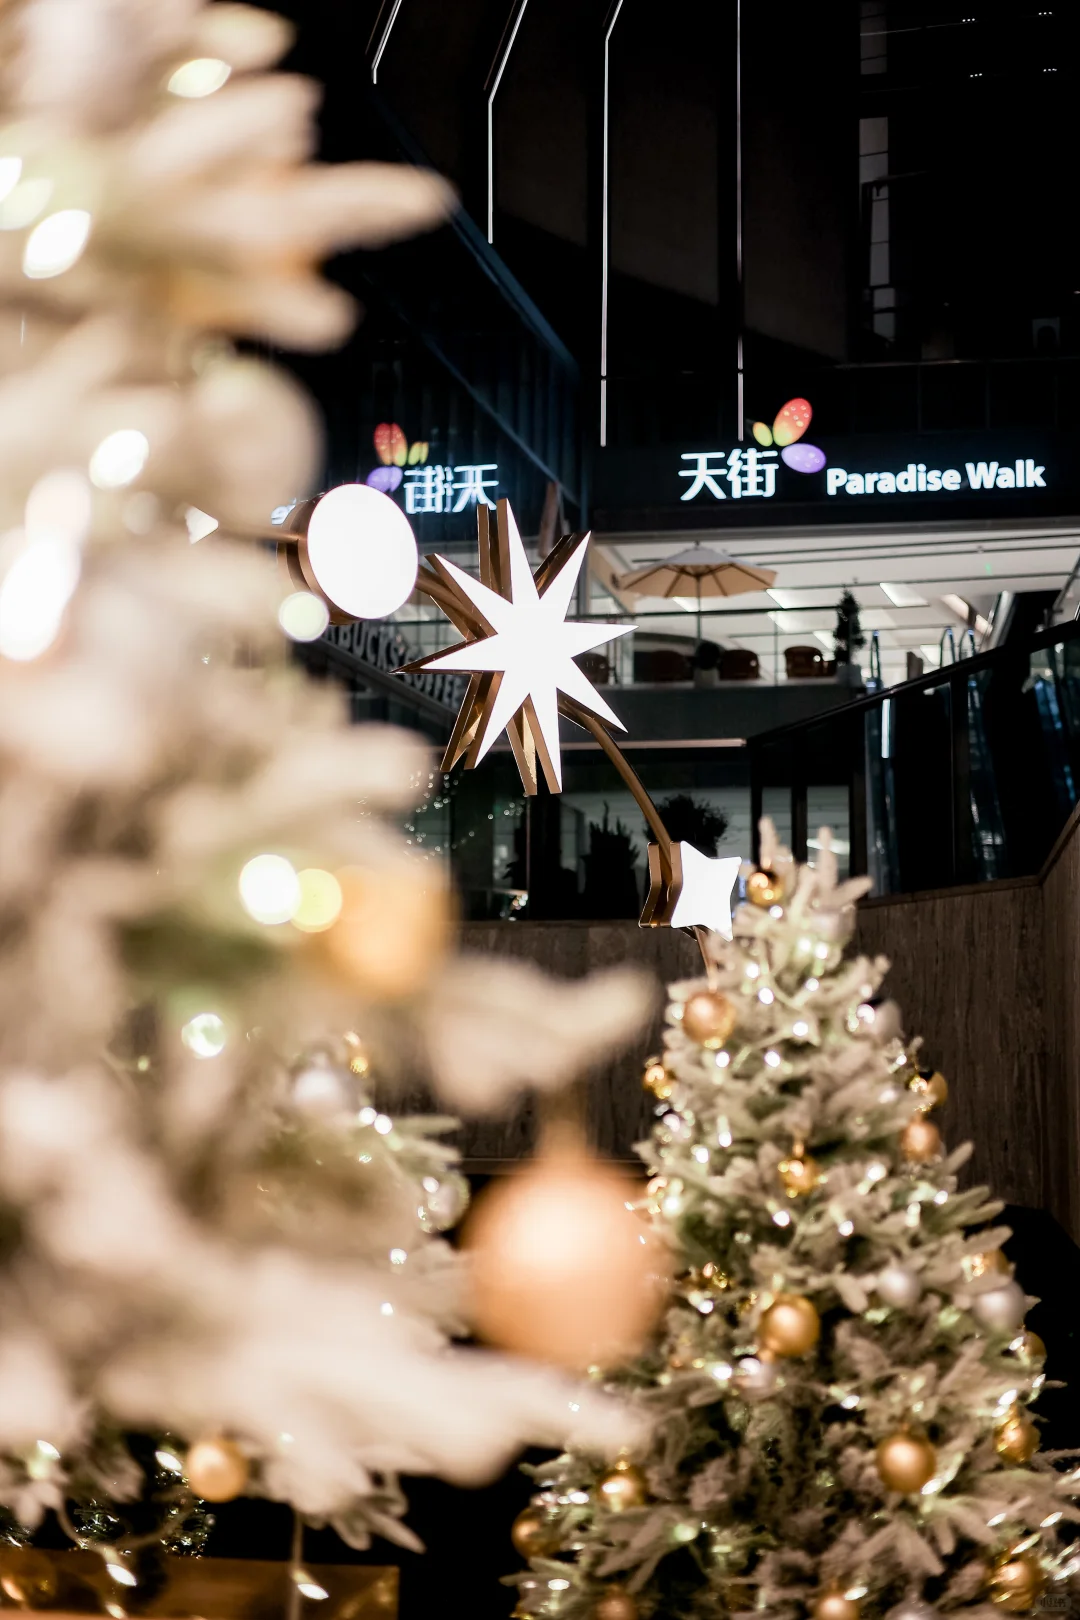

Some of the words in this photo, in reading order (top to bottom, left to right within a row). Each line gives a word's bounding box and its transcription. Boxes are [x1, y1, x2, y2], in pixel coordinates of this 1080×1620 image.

[678, 448, 779, 501] 天街
[826, 463, 962, 496] Paradise
[965, 458, 1047, 490] Walk
